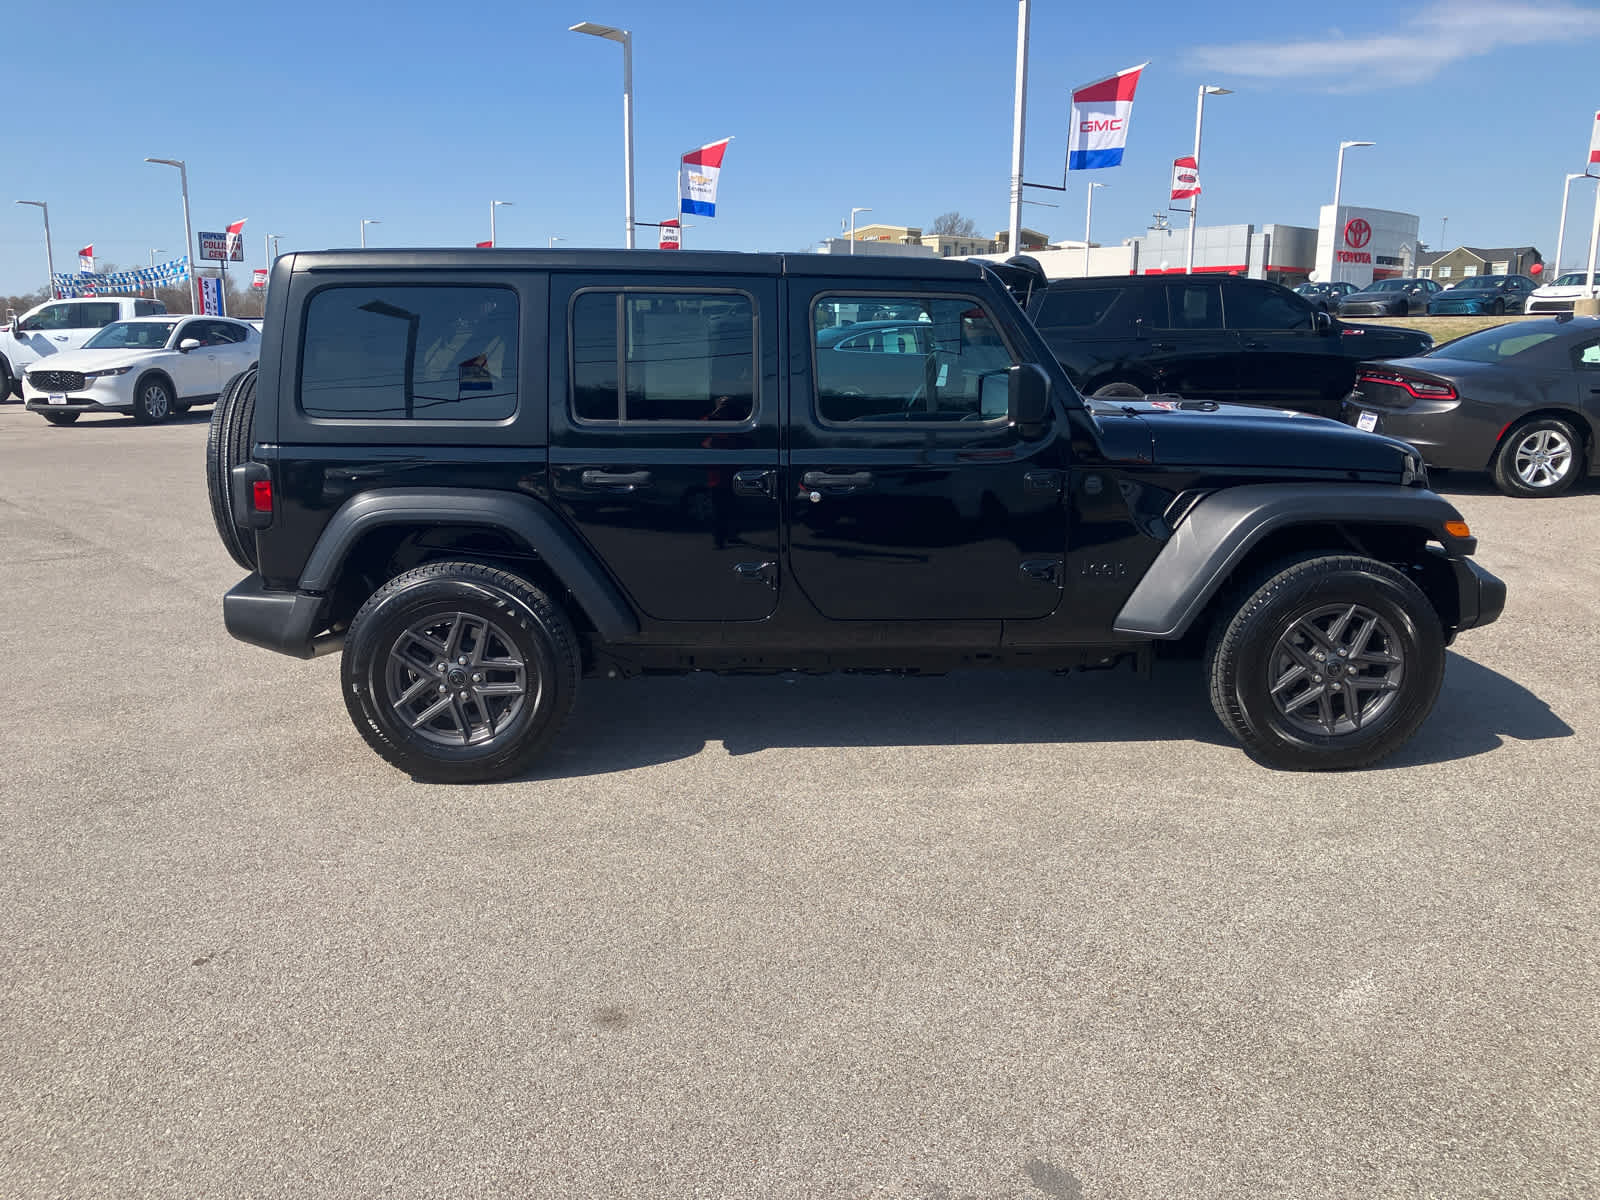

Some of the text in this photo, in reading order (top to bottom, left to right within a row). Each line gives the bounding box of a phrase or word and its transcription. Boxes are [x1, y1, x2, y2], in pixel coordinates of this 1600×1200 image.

[1080, 119, 1122, 132] GMC
[203, 241, 240, 250] COLLISON
[209, 250, 237, 258] CENTR
[1337, 251, 1371, 264] TOYOTA
